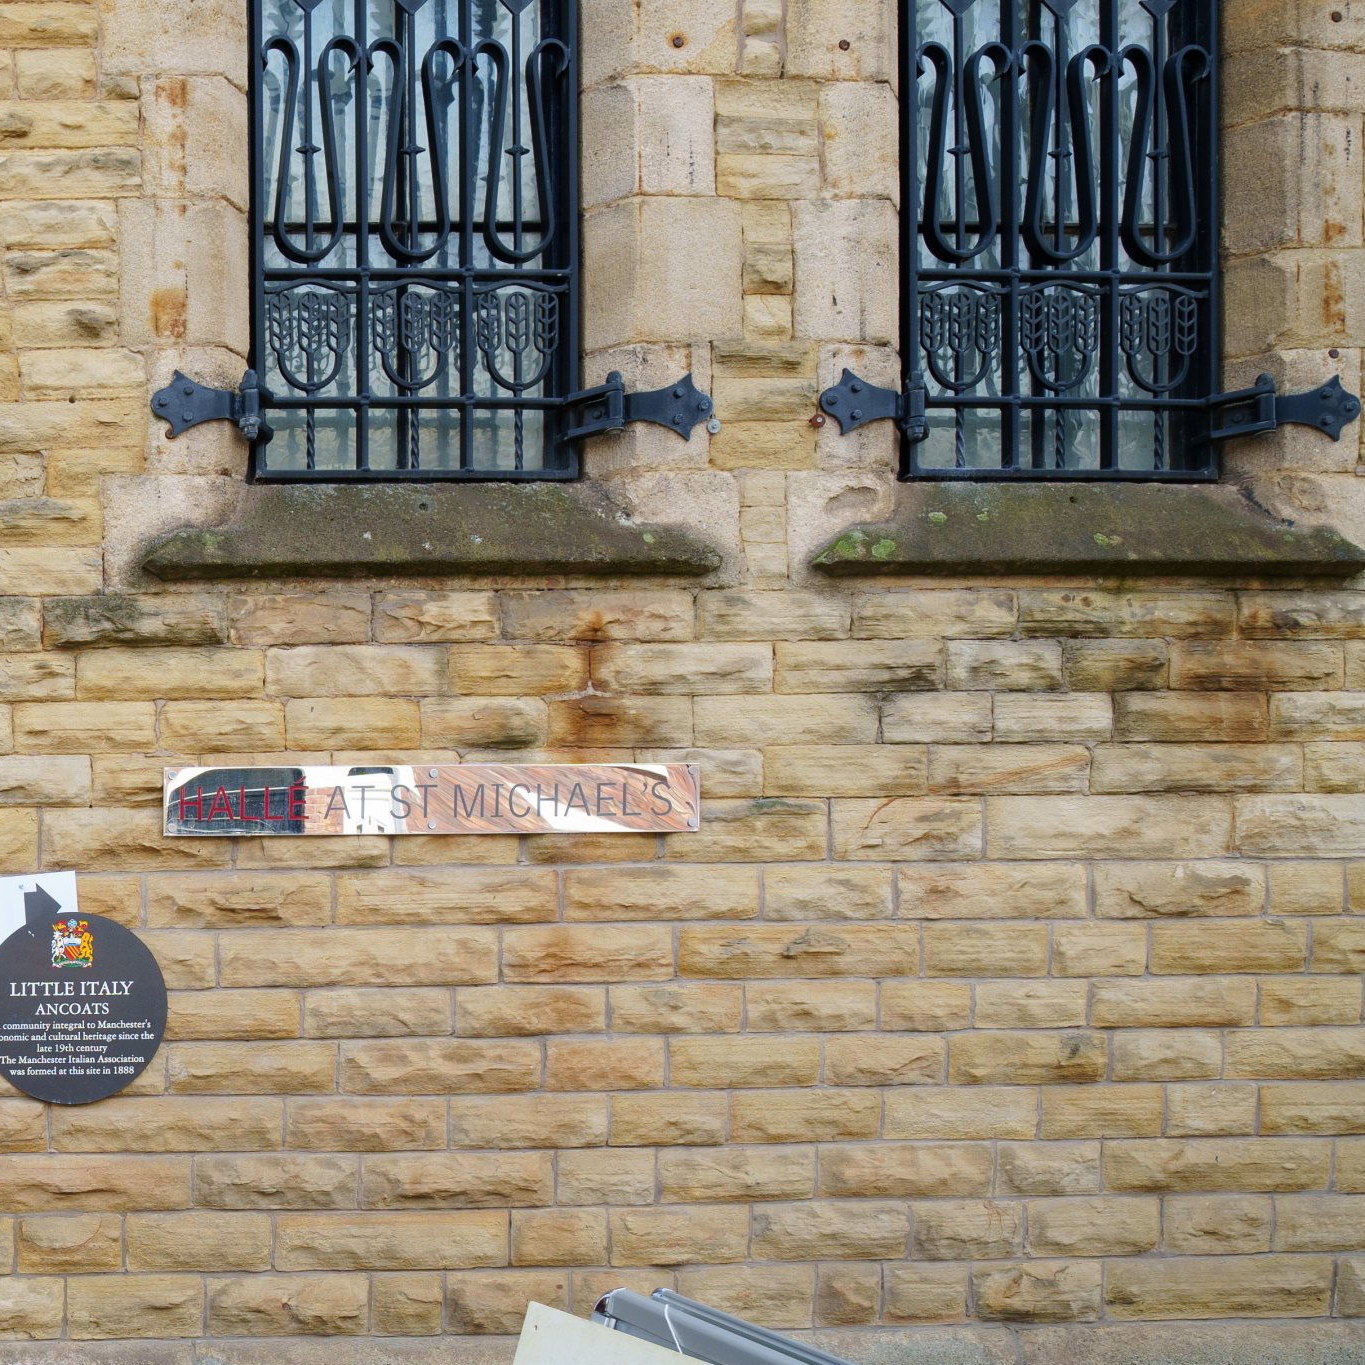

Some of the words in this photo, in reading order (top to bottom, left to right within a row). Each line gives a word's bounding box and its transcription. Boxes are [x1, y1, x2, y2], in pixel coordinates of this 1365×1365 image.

[179, 776, 310, 822] HALLÉ
[323, 784, 376, 819] AT
[389, 783, 438, 819] ST
[9, 981, 75, 997] LITTLE
[79, 980, 134, 996] ITALY
[34, 1002, 110, 1016] ANCOATS
[2, 1021, 51, 1032] community
[52, 1020, 85, 1032] integral
[87, 1021, 96, 1029] to
[97, 1018, 151, 1029] Manchester's
[31, 1032, 47, 1041] and
[48, 1032, 81, 1041] cultural
[82, 1031, 117, 1042] heritage
[118, 1031, 139, 1040] since
[140, 1030, 155, 1040] the
[36, 1043, 53, 1053] late
[55, 1043, 75, 1052] 19th
[76, 1045, 108, 1054] century
[0, 1055, 17, 1065] The
[18, 1055, 66, 1064] Manchester
[68, 1054, 96, 1064] Italian
[97, 1054, 145, 1064] Association
[9, 1068, 25, 1076] was
[27, 1066, 57, 1076] formed
[58, 1067, 67, 1075] at
[69, 1065, 85, 1075] this
[86, 1066, 101, 1075] site
[102, 1066, 111, 1075] in
[113, 1065, 135, 1075] 1888
